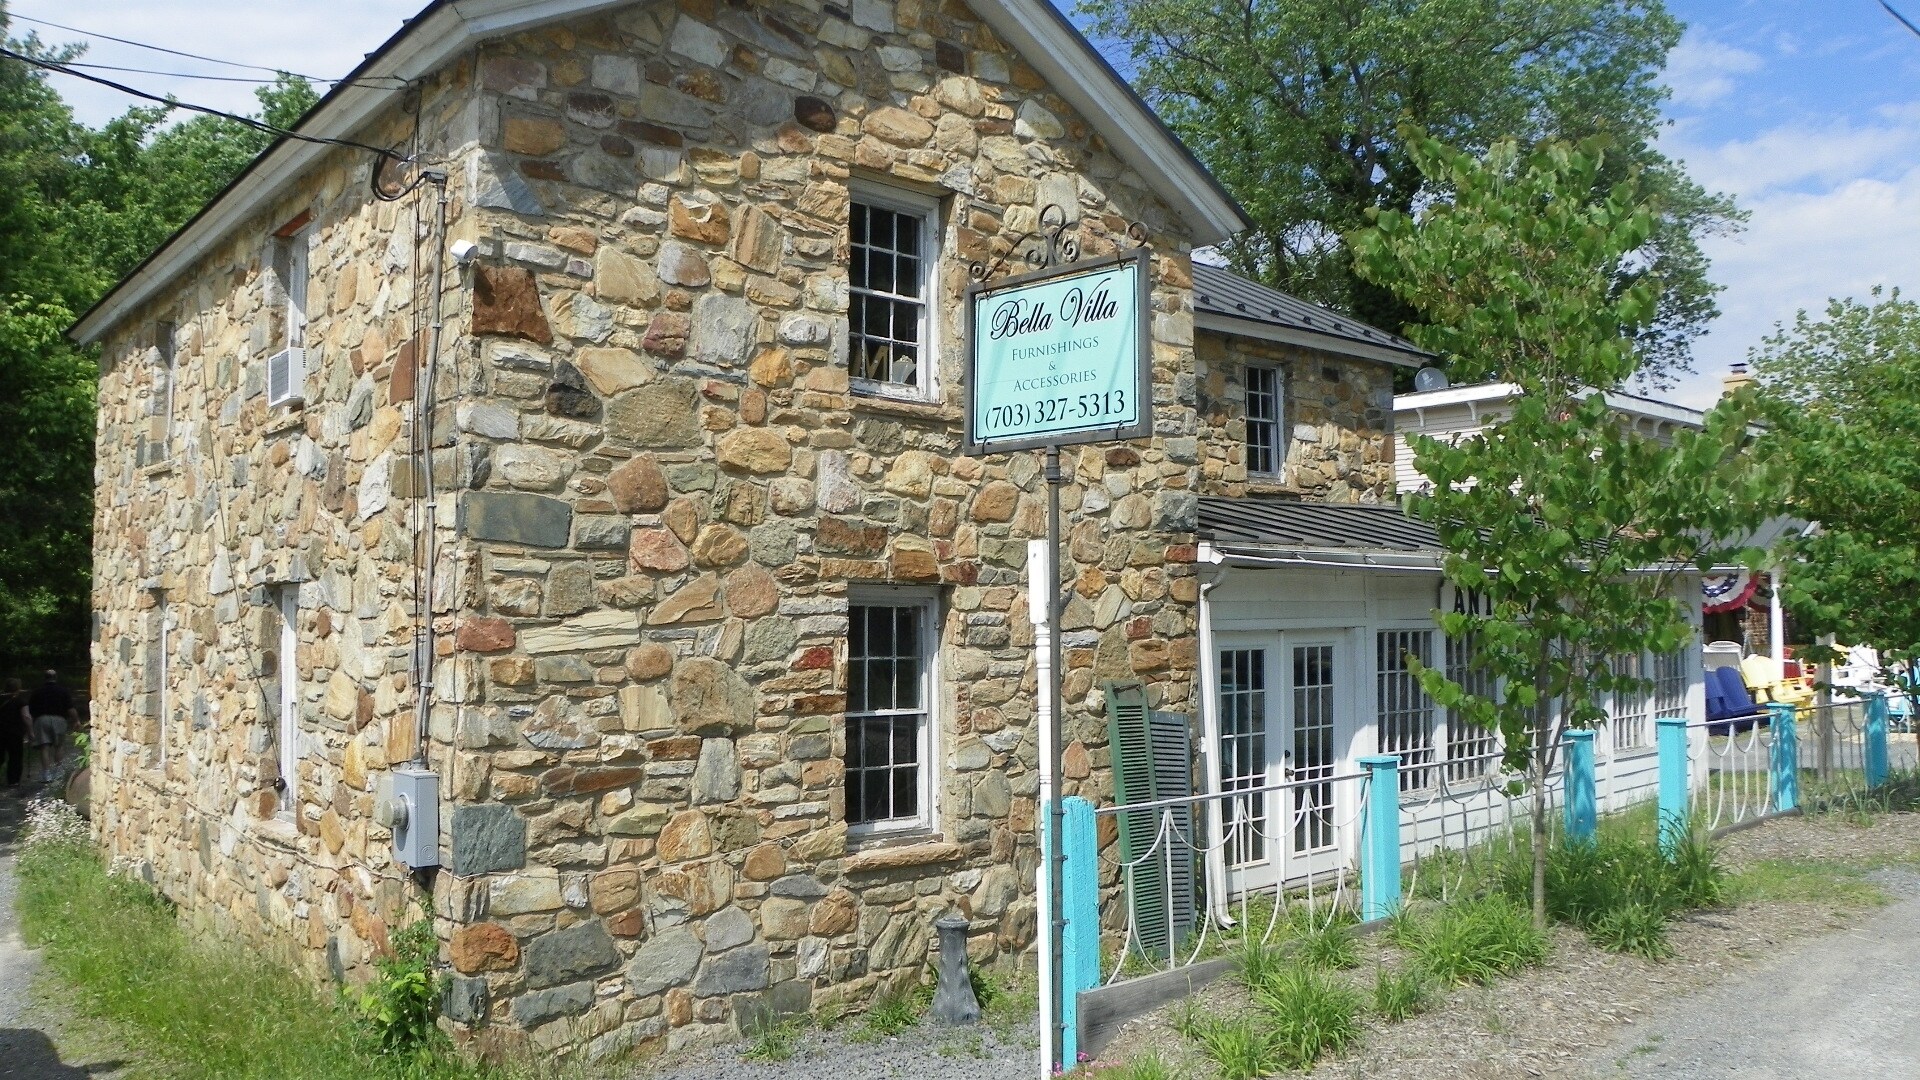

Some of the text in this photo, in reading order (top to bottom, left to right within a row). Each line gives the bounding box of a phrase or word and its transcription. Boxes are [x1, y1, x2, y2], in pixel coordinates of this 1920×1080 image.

[990, 277, 1119, 340] Bella Villa
[1012, 336, 1099, 361] FURNISHINGS
[1048, 361, 1056, 371] &
[1013, 369, 1097, 392] ACCESSORIES
[985, 389, 1125, 432] (703) 327-5313
